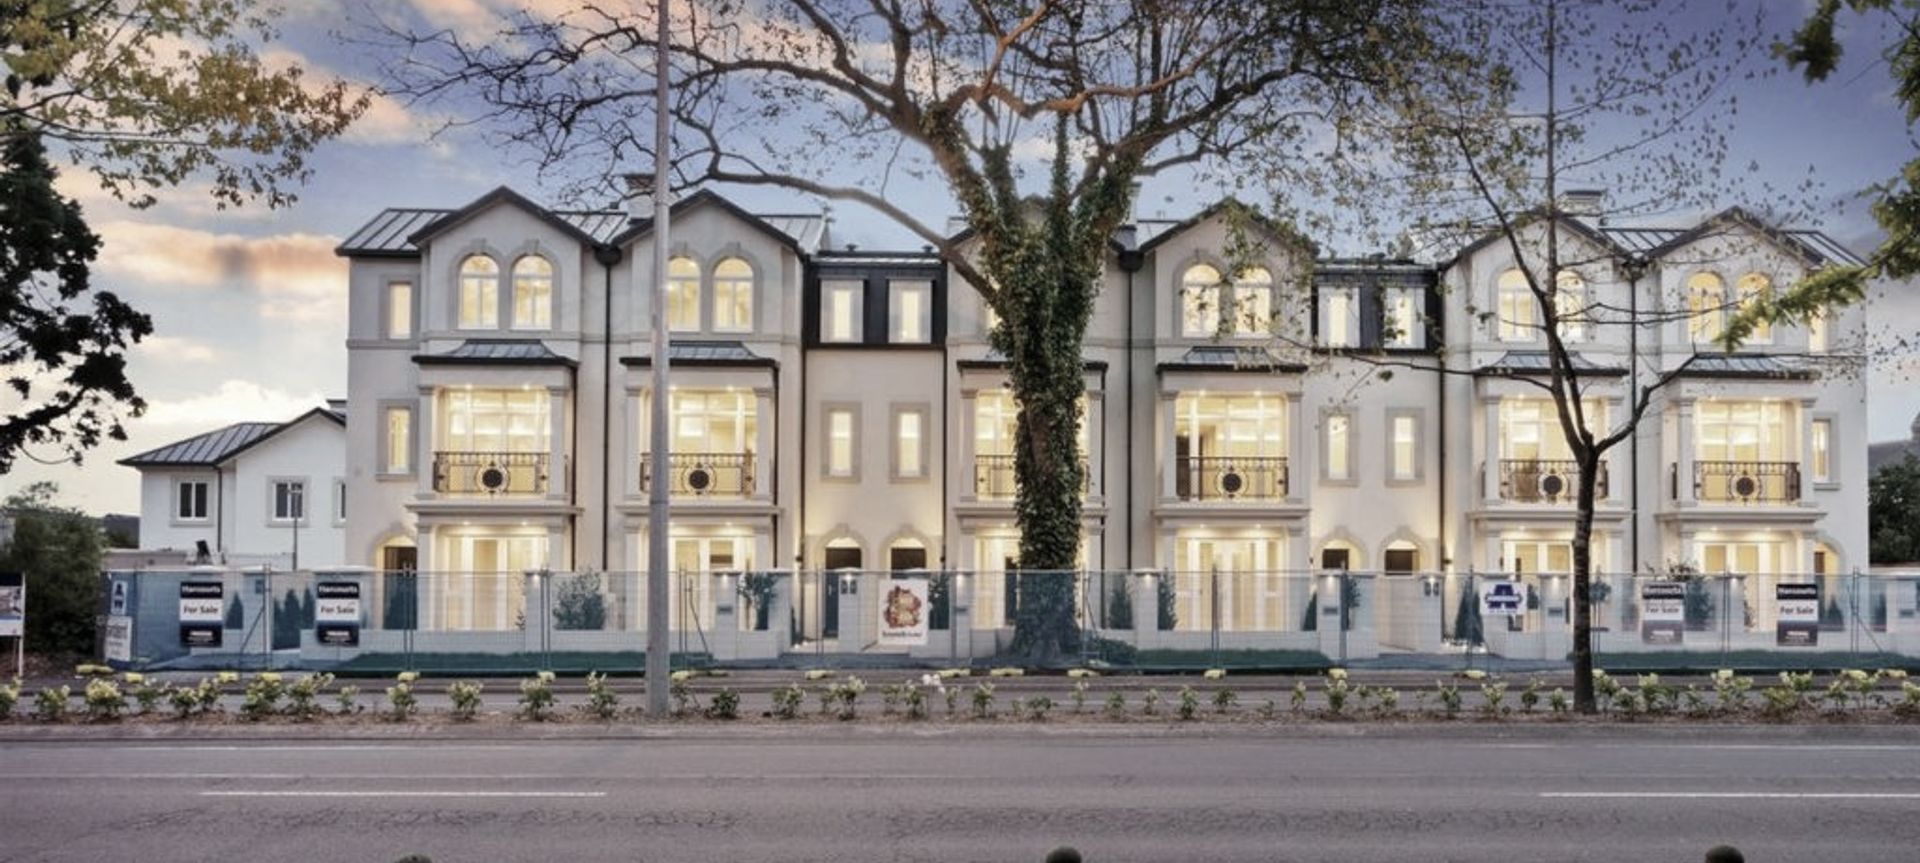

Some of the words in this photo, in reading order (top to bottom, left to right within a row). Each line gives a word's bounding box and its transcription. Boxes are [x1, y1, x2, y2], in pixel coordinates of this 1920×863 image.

[183, 605, 197, 614] For
[200, 605, 219, 614] Sale
[320, 605, 334, 614] For
[336, 605, 355, 614] Sale
[1645, 604, 1659, 613] For
[1662, 605, 1680, 614] Sale
[1780, 605, 1794, 614] For
[1796, 605, 1815, 614] Sale
